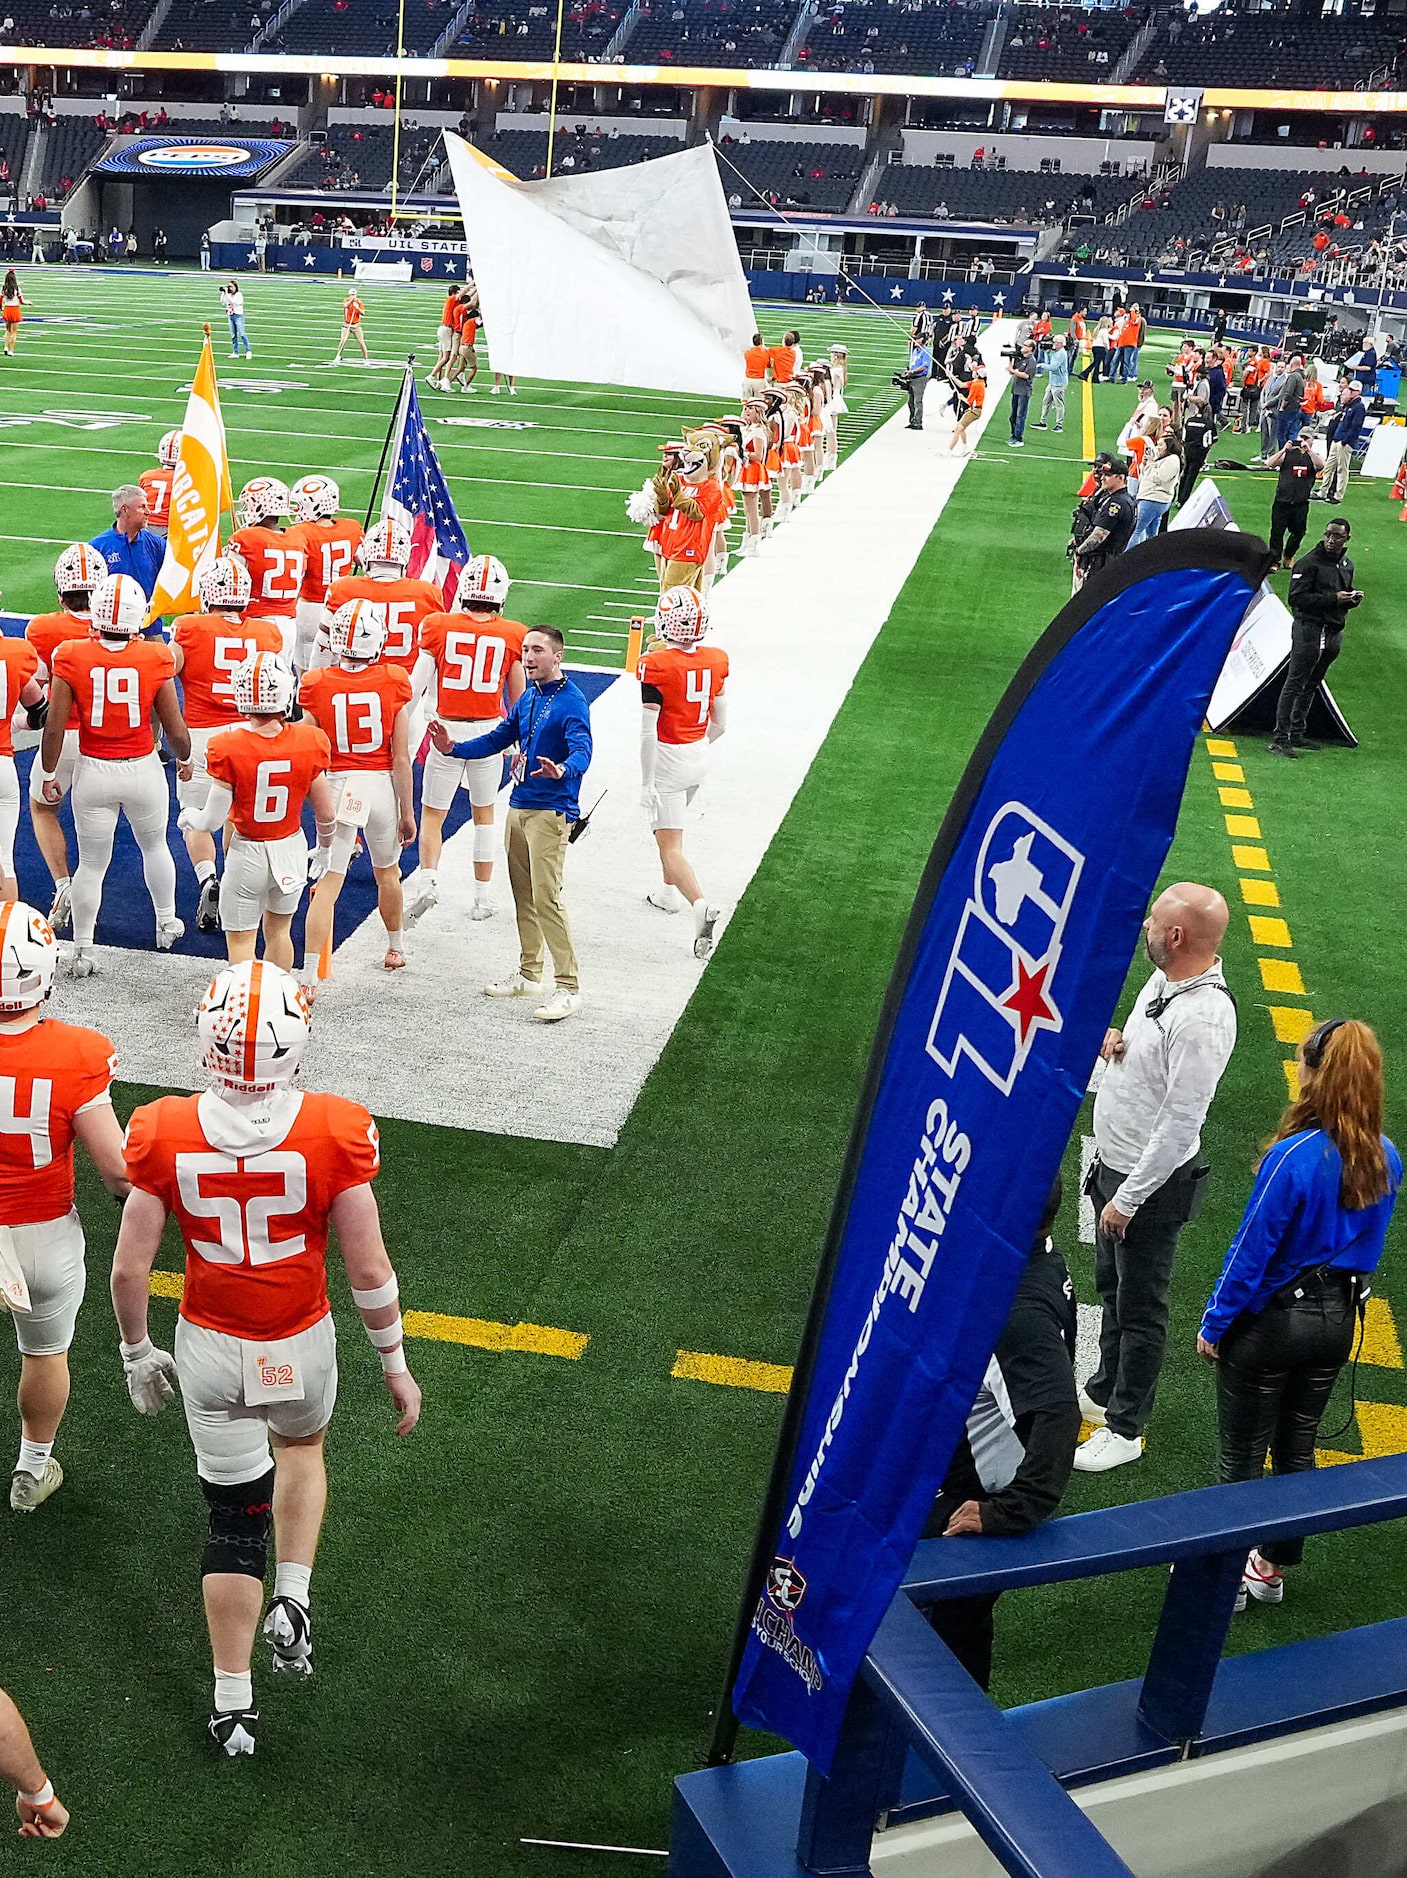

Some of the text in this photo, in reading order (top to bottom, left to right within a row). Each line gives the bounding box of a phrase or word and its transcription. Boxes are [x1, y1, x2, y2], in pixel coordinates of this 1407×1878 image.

[1168, 98, 1195, 121] 25
[388, 240, 468, 252] UIL STATE
[151, 480, 168, 514] 7
[261, 548, 304, 599] 23
[320, 539, 352, 586] 12
[442, 631, 507, 694] 50
[89, 666, 141, 729] 19
[331, 691, 384, 754] 13
[686, 668, 712, 725] 4
[253, 759, 291, 823] 6
[223, 1078, 276, 1093] Riddell
[174, 1150, 307, 1267] 52
[889, 1117, 972, 1314] STATE
[261, 1363, 295, 1386] 52
